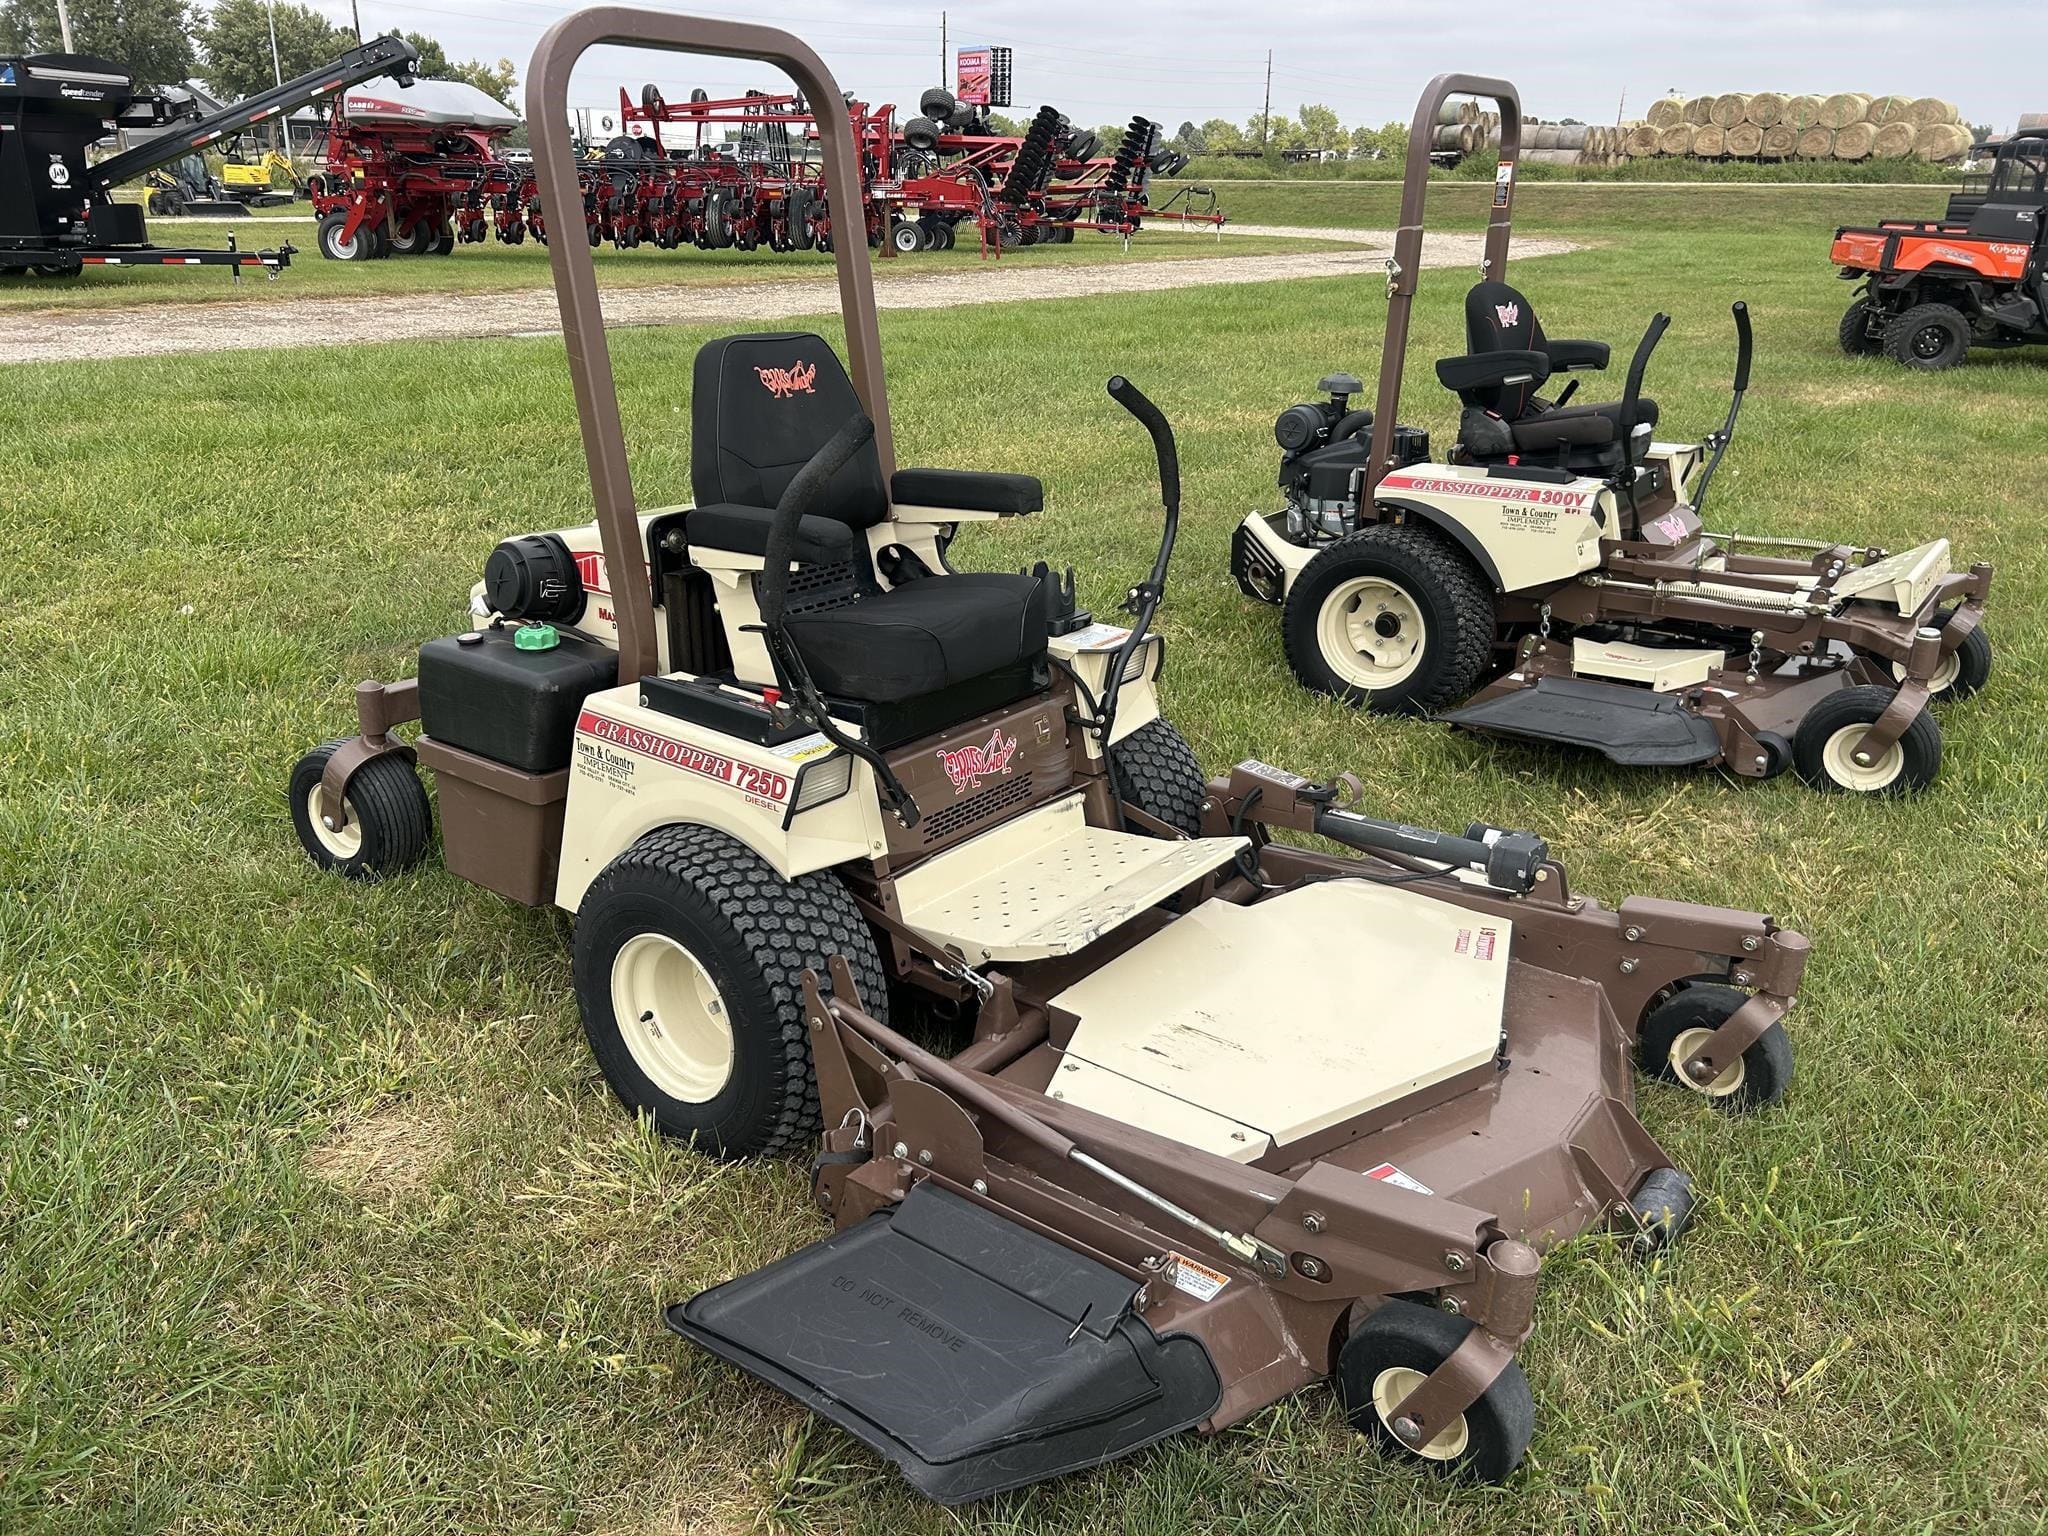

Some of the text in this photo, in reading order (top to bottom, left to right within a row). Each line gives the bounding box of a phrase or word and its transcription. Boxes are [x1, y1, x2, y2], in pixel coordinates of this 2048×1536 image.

[1989, 242, 2028, 256] Kubota
[1410, 478, 1588, 507] GRASSHOPPER 300V
[1502, 505, 1559, 521] Town & Country
[1507, 516, 1551, 527] IMPLEMENT
[576, 737, 635, 773] Town & Country
[594, 719, 728, 779] GRASSHOPPER
[736, 763, 788, 801] 725D
[583, 755, 629, 781] IMPLEMENT
[744, 794, 780, 813] DIESEL
[1480, 927, 1497, 936] 61
[1182, 1259, 1219, 1280] WARNING
[831, 1275, 967, 1353] DO NOT REMOVE
